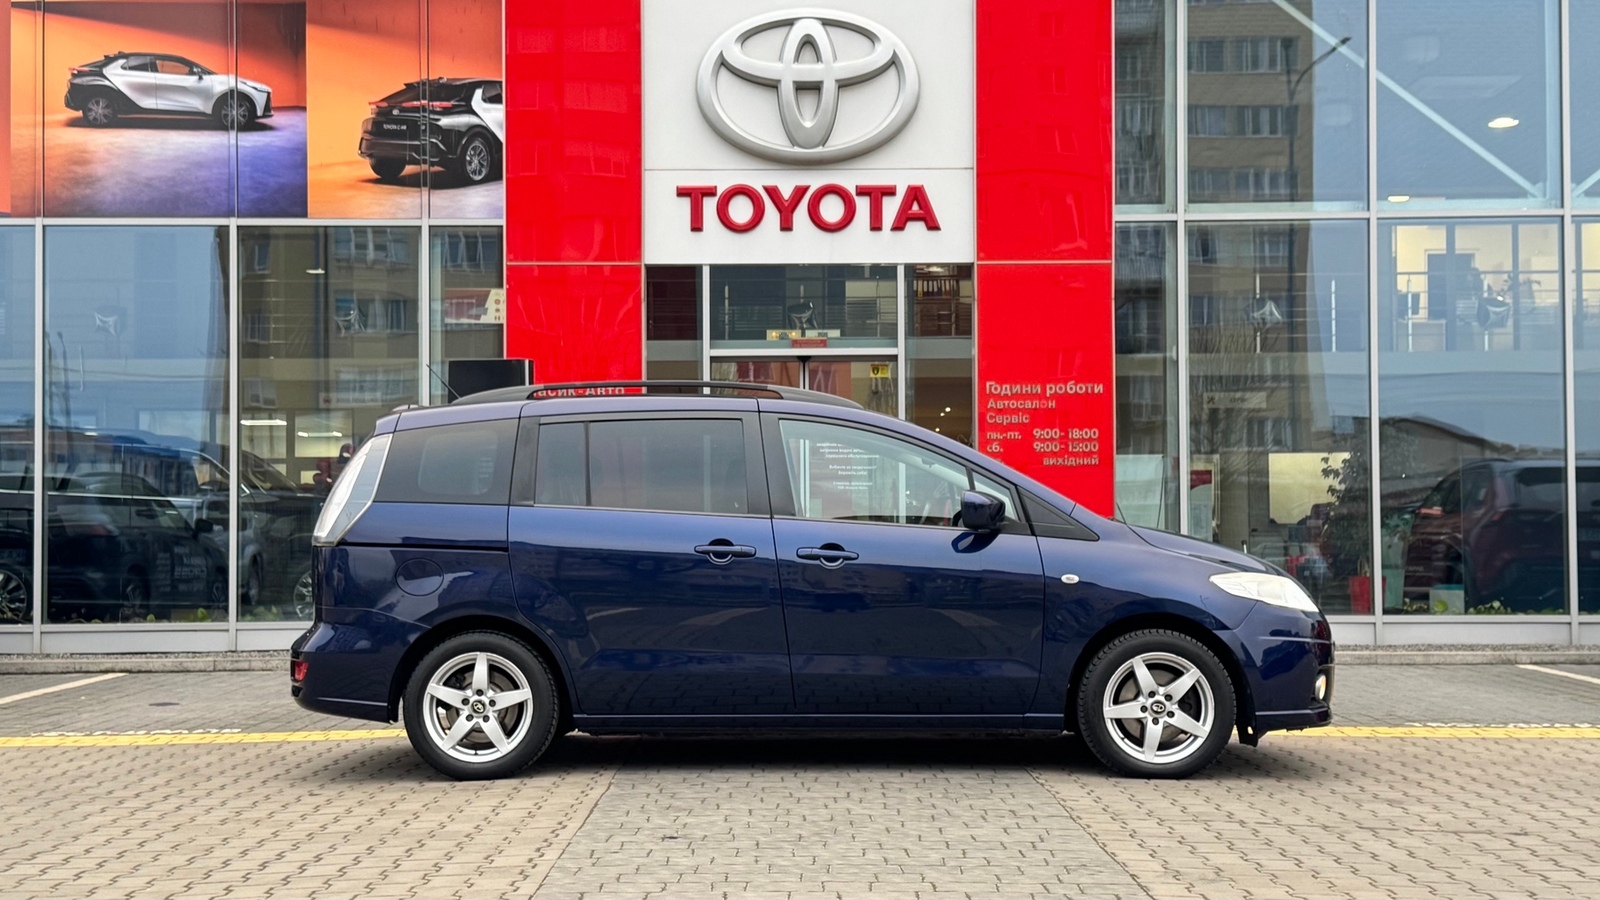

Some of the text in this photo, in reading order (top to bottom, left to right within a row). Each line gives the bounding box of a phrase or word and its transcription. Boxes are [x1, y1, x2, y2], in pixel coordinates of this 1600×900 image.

[676, 183, 942, 233] TOYOTA
[985, 380, 1104, 397] Години роботи
[987, 398, 1056, 409] Автосалон
[986, 412, 1030, 426] Сервіс
[986, 441, 1003, 452] сб.
[1043, 455, 1099, 466] вихідний
